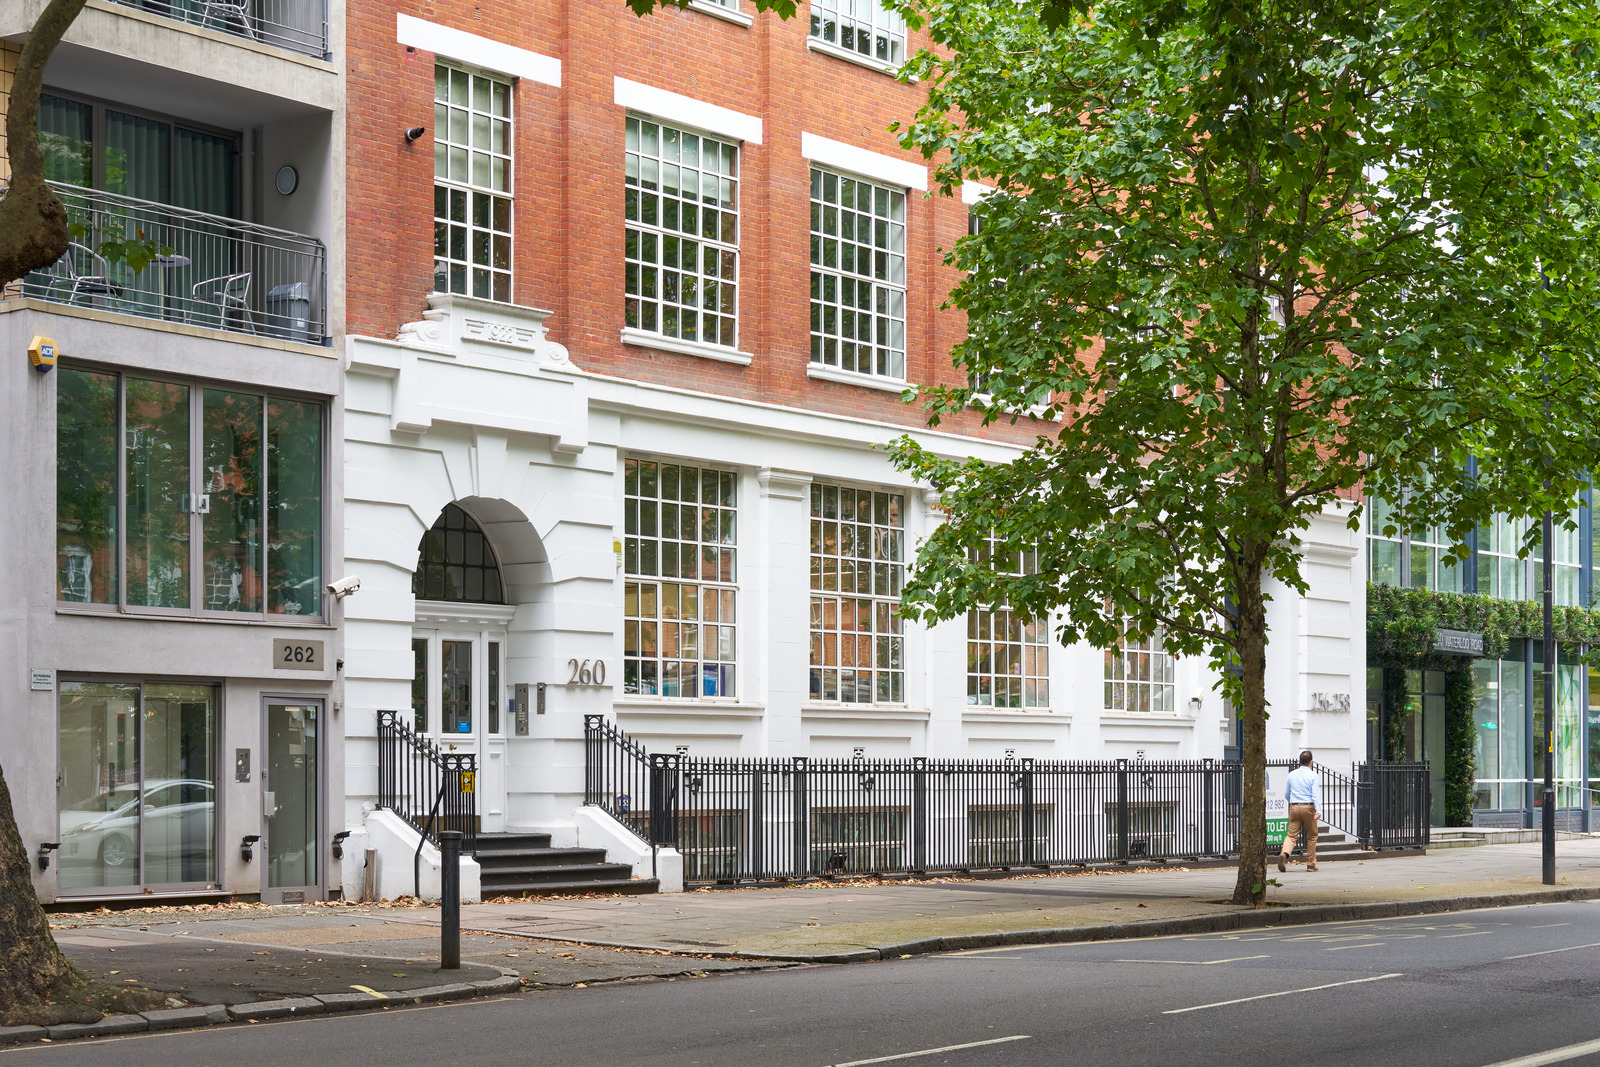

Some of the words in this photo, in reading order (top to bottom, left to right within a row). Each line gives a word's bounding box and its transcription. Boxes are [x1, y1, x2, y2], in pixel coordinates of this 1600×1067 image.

[41, 347, 54, 356] ADT
[1444, 635, 1469, 649] WATERLOO
[1470, 638, 1484, 651] ROAD
[283, 645, 315, 663] 262
[567, 658, 606, 685] 260
[1311, 692, 1351, 711] 256-258
[1274, 799, 1285, 809] 982
[1266, 822, 1275, 832] TO
[1276, 821, 1288, 832] LET
